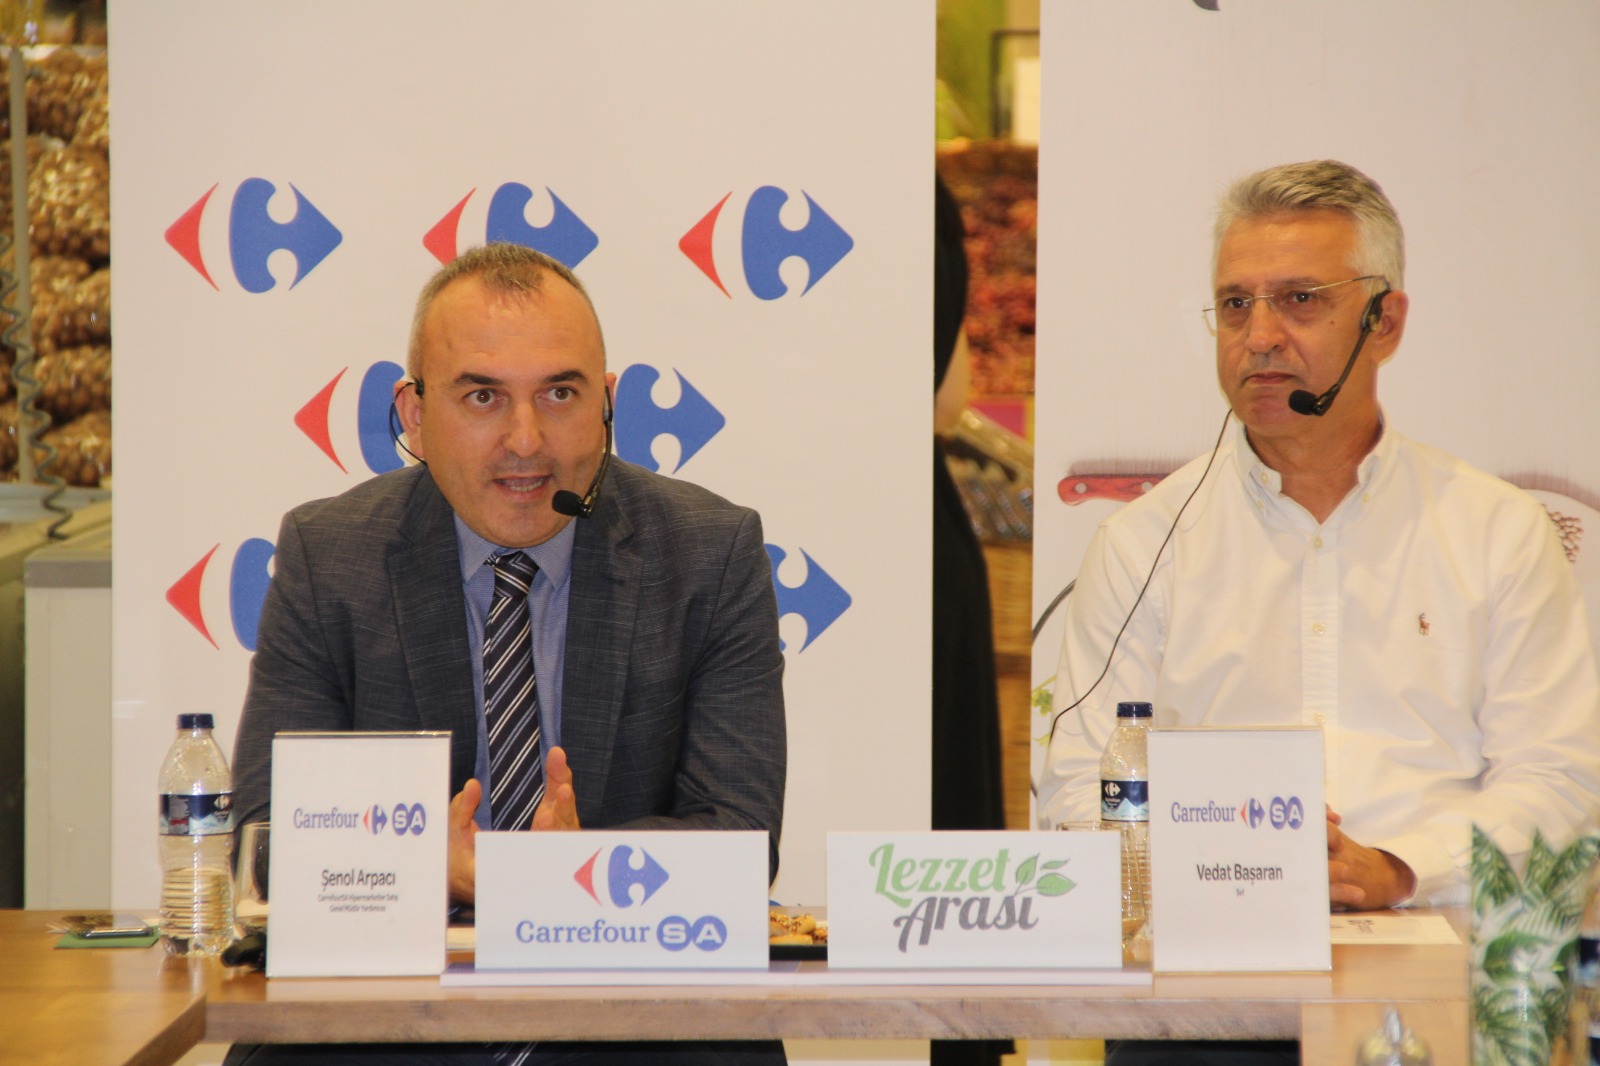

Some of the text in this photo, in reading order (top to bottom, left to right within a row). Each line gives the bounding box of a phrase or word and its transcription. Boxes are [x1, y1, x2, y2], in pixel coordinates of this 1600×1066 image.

[293, 807, 359, 829] Carrefour
[1171, 800, 1237, 823] Carrefour
[321, 868, 396, 891] Şenol Arpacı
[869, 843, 1011, 909] Lezzet
[1196, 863, 1283, 886] Vedat Başaran
[515, 919, 650, 943] Carrefour
